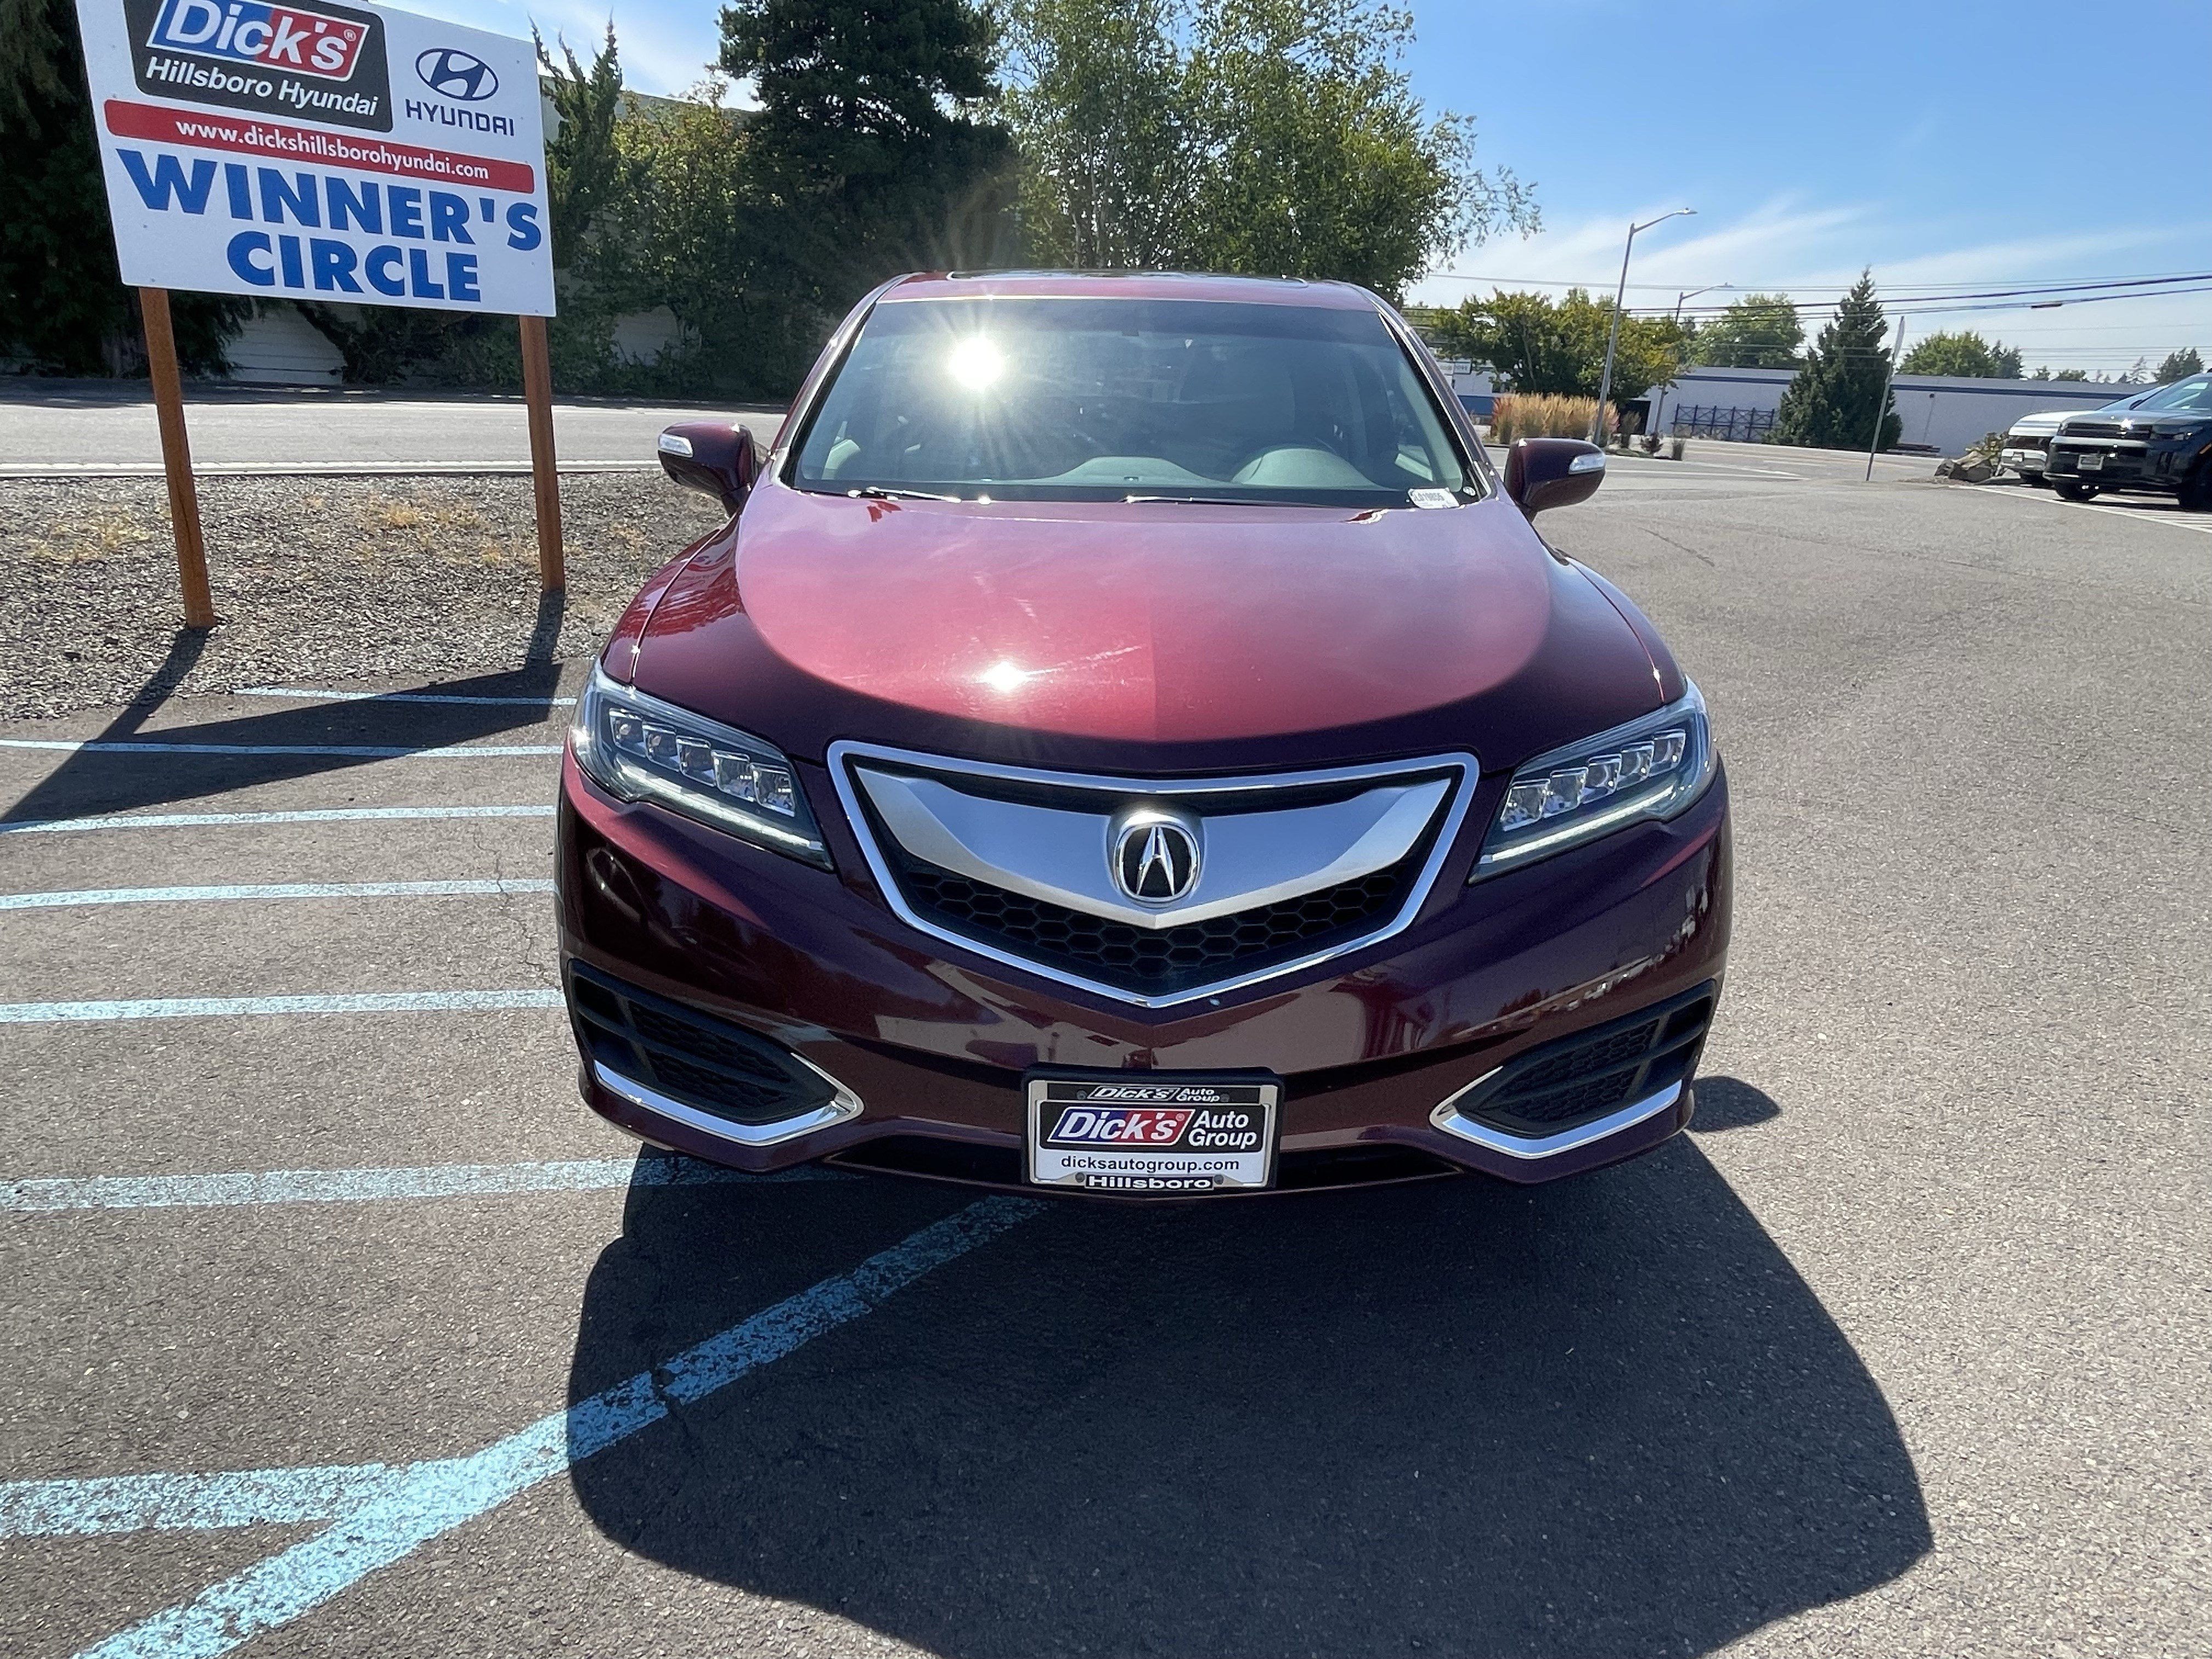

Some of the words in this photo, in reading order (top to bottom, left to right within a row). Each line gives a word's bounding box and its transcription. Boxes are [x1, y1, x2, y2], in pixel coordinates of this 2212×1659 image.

[166, 0, 348, 70] Dick's
[145, 57, 273, 98] Hillsboro
[278, 80, 379, 116] Hyundai
[405, 99, 515, 137] HYUNDAI
[176, 117, 489, 180] www.dickshillsborohyundai.com
[116, 148, 542, 251] WINNER'S
[227, 231, 481, 302] CIRCLE
[1177, 1094, 1221, 1103] Group
[1058, 1111, 1177, 1141] Dick's
[1193, 1110, 1249, 1129] Auto
[1188, 1128, 1257, 1150] Group
[1061, 1155, 1239, 1173] dicksautogroup.com
[1088, 1175, 1211, 1189] Hillsboro
